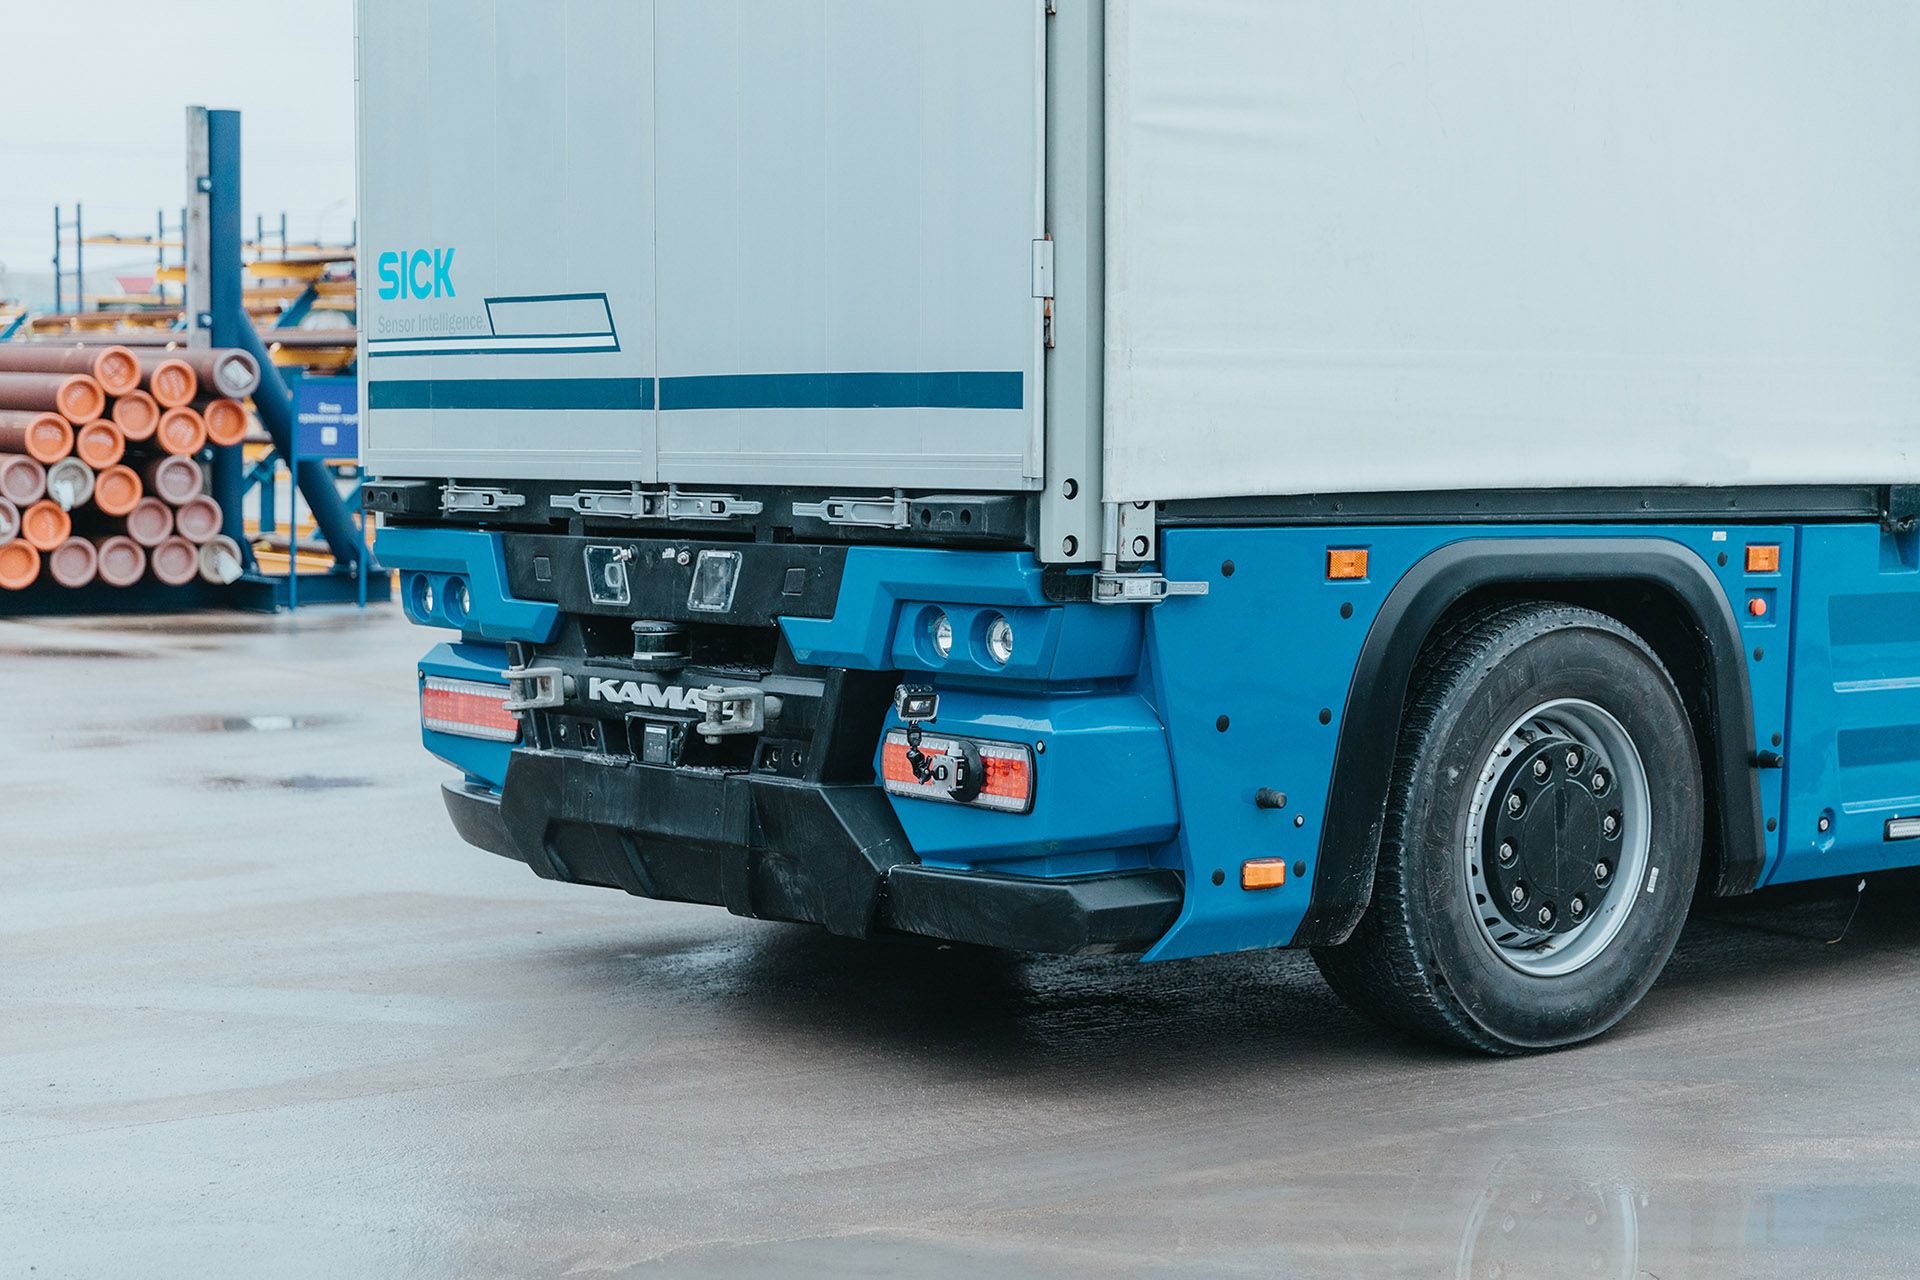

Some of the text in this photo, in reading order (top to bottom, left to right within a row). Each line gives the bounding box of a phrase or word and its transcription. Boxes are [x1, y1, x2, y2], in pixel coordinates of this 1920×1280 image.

[378, 248, 456, 300] SICK
[378, 312, 487, 335] Sensor Intelligence.
